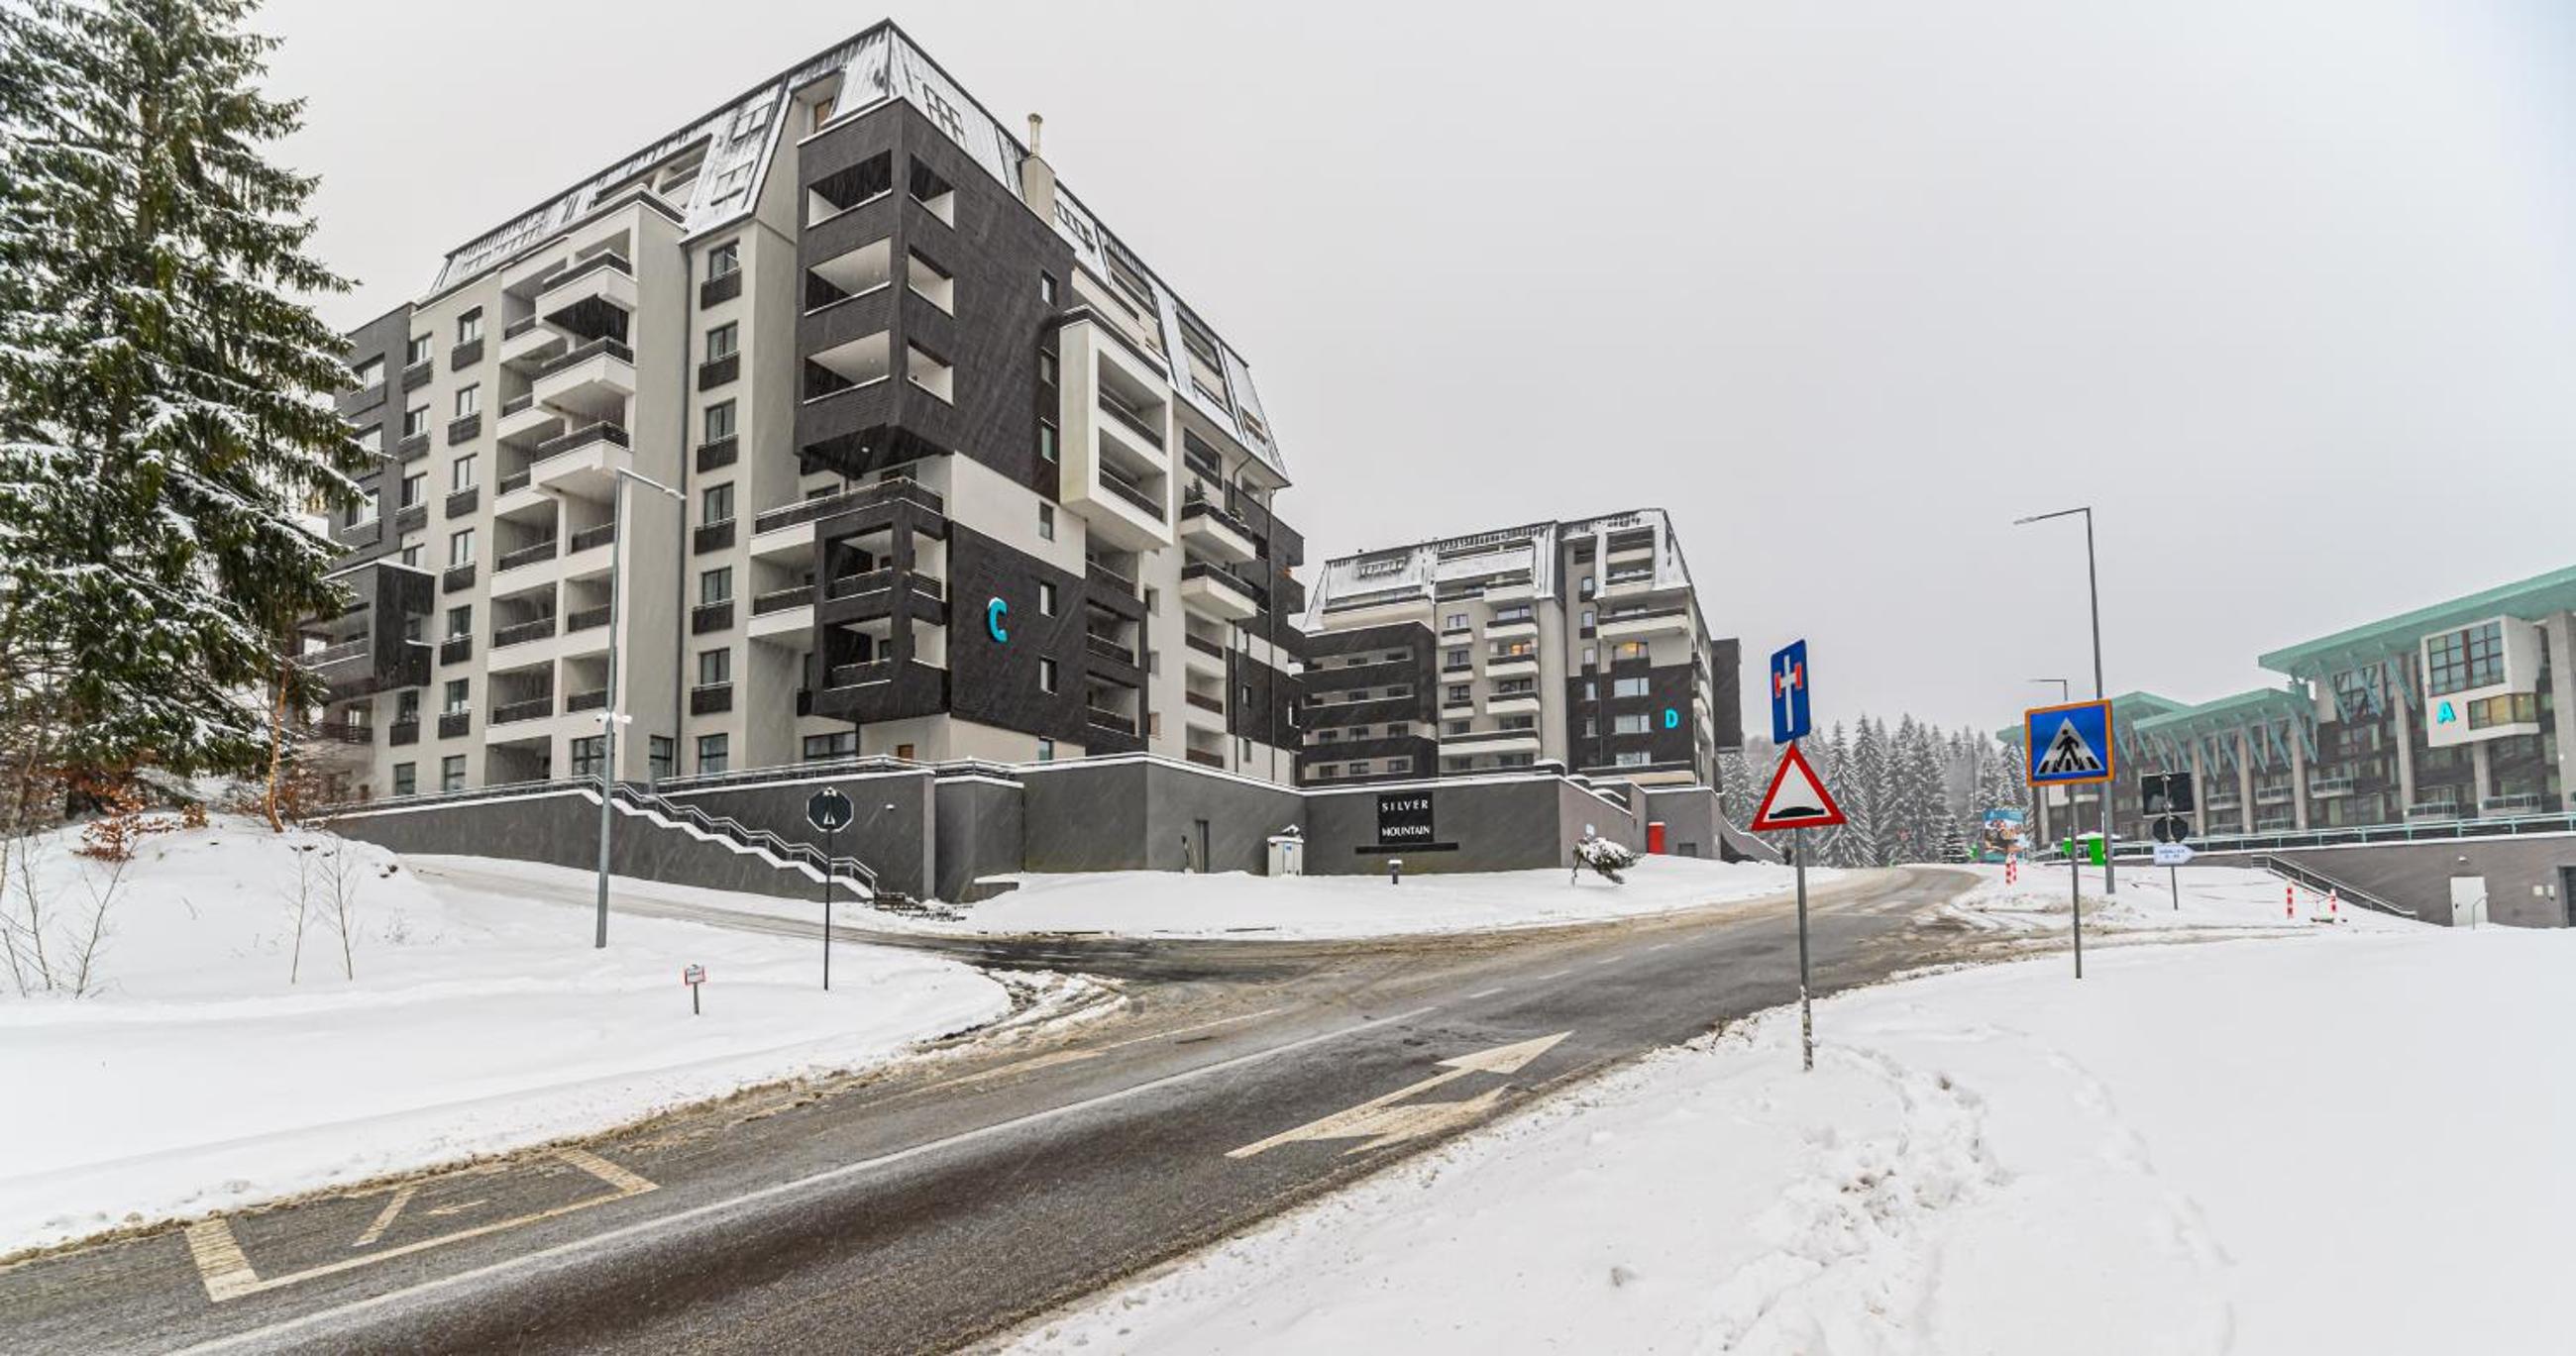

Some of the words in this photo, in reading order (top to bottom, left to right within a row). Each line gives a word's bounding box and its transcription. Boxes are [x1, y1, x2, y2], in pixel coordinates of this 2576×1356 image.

[988, 596, 1008, 643] C
[1664, 708, 1678, 729] D
[2437, 701, 2456, 724] A
[1382, 799, 1429, 812] SILVER
[1382, 825, 1431, 837] MOUNTAIN
